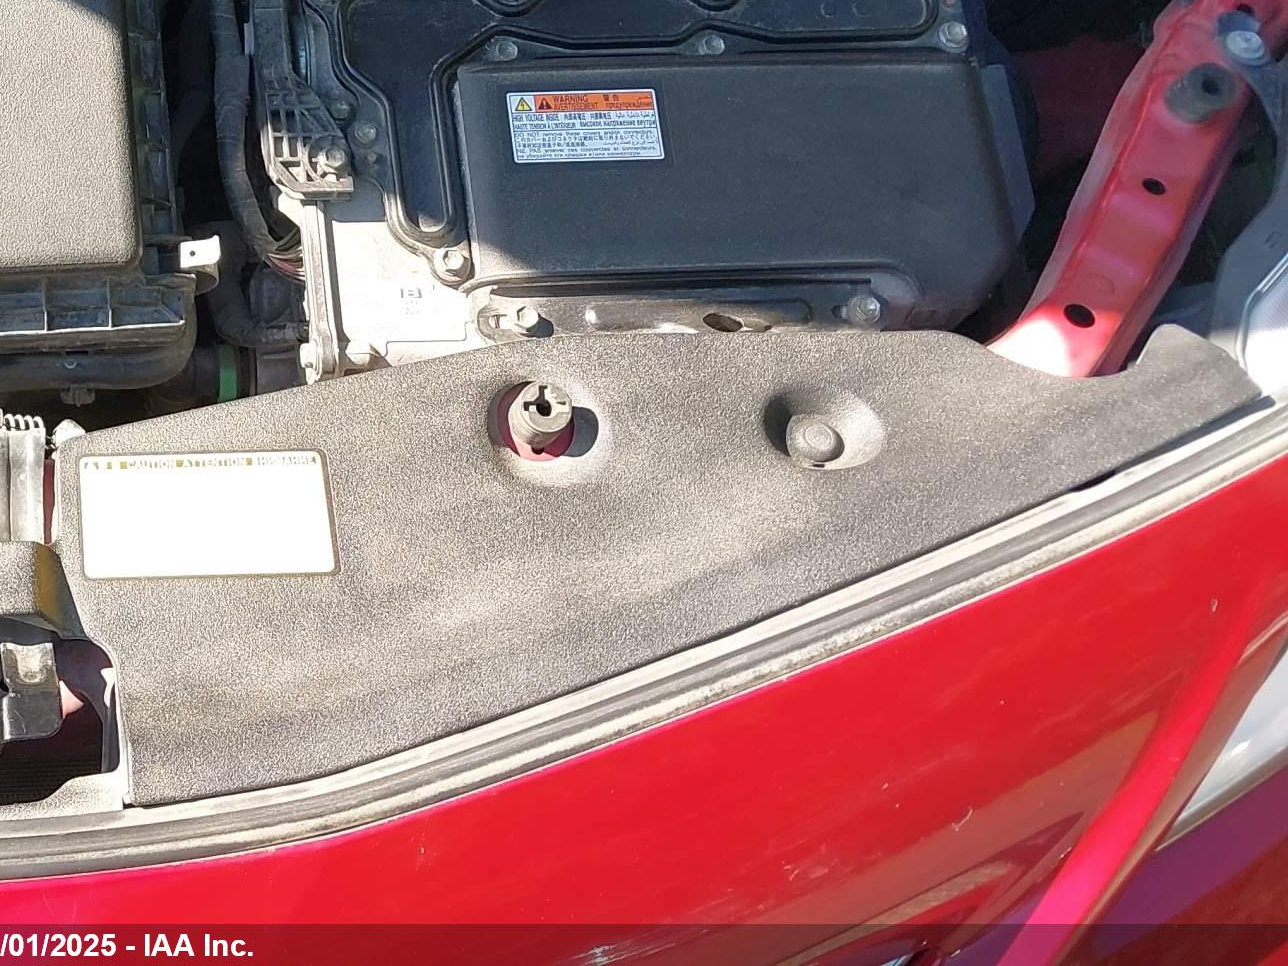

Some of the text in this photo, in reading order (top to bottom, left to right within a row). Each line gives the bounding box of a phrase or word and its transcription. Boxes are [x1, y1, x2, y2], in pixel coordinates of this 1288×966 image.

[553, 94, 588, 103] WARNING
[127, 457, 246, 469] CAUTION ATTENTION
